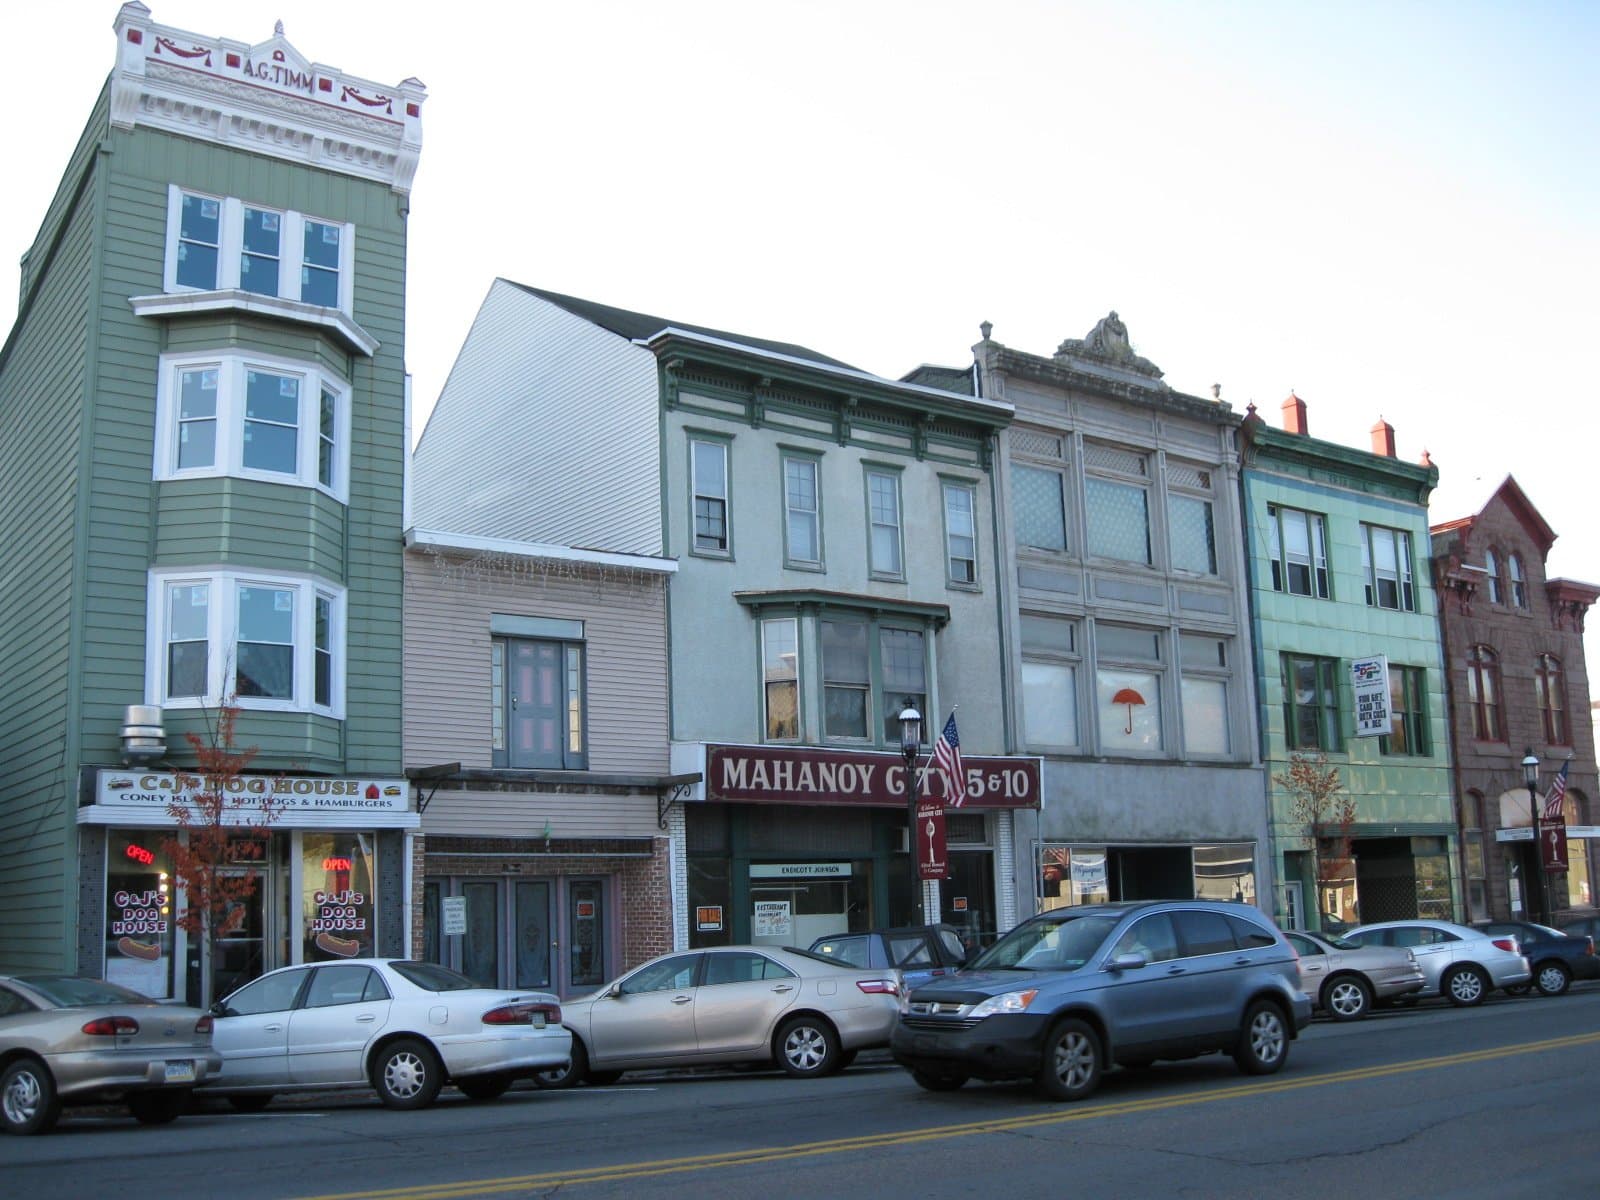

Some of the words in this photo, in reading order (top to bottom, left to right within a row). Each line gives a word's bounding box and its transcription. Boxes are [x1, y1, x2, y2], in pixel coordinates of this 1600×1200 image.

[722, 757, 875, 794] MAHANOY
[885, 766, 952, 798] CTY
[139, 775, 201, 794] C&J
[273, 778, 360, 796] HOUSE
[120, 793, 166, 801] CONEY
[171, 795, 225, 804] ISL
[315, 799, 393, 808] HAMBURGERS
[126, 844, 155, 865] OPEN
[323, 858, 352, 871] OPEN
[115, 891, 167, 907] C&J's
[313, 890, 364, 906] C&J's
[124, 908, 158, 921] DOG
[322, 906, 356, 918] DOG
[113, 921, 168, 934] HOUSE
[312, 918, 366, 931] HOUSE
